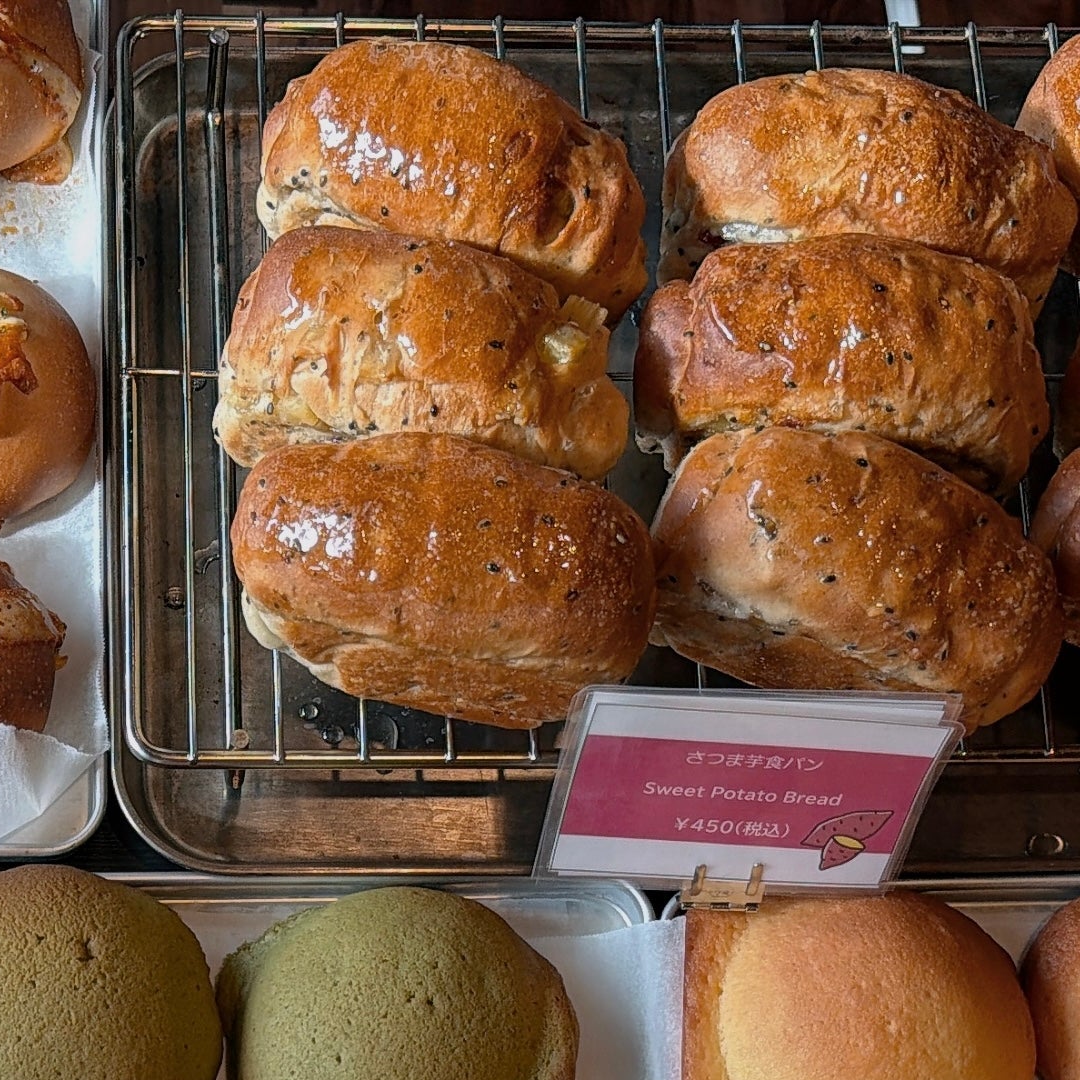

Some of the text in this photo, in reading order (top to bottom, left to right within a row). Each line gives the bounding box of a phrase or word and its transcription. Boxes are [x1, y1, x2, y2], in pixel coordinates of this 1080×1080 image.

[685, 751, 824, 772] さつま芋食パン
[643, 781, 843, 807] Sweet Potato Bread
